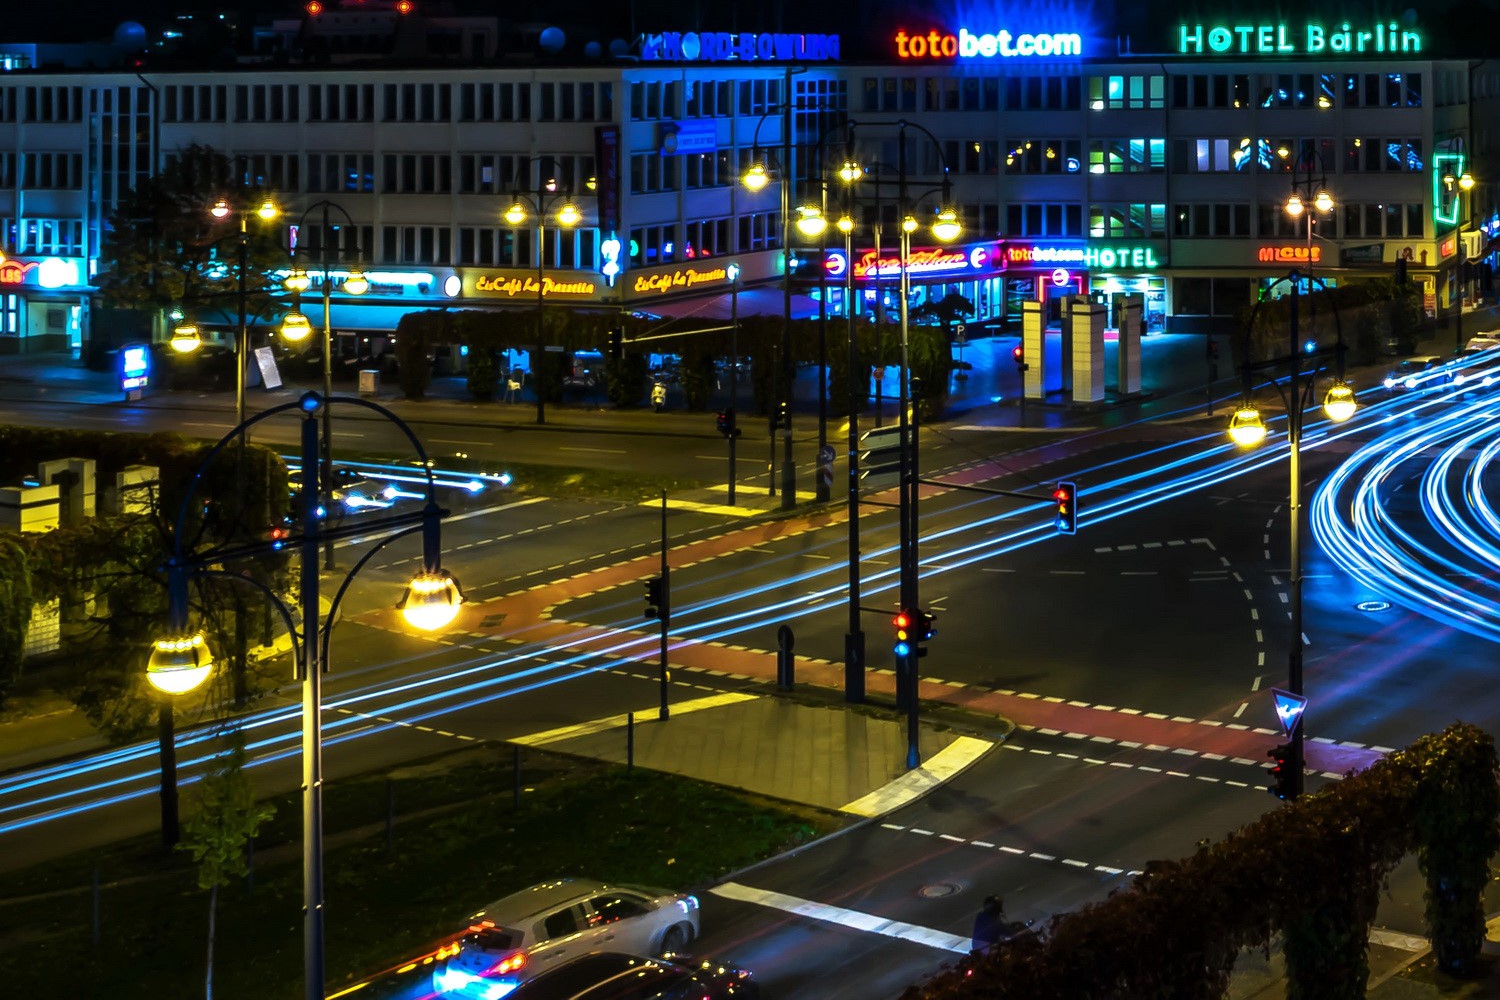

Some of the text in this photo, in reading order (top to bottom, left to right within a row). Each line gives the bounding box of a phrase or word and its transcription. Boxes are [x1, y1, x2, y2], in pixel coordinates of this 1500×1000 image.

[895, 28, 1082, 57] totobet.com
[1179, 24, 1294, 53] HOTEL
[865, 78, 997, 93] PENSON
[1086, 247, 1158, 268] HOTEL
[0, 269, 22, 283] LBS
[956, 324, 965, 335] P
